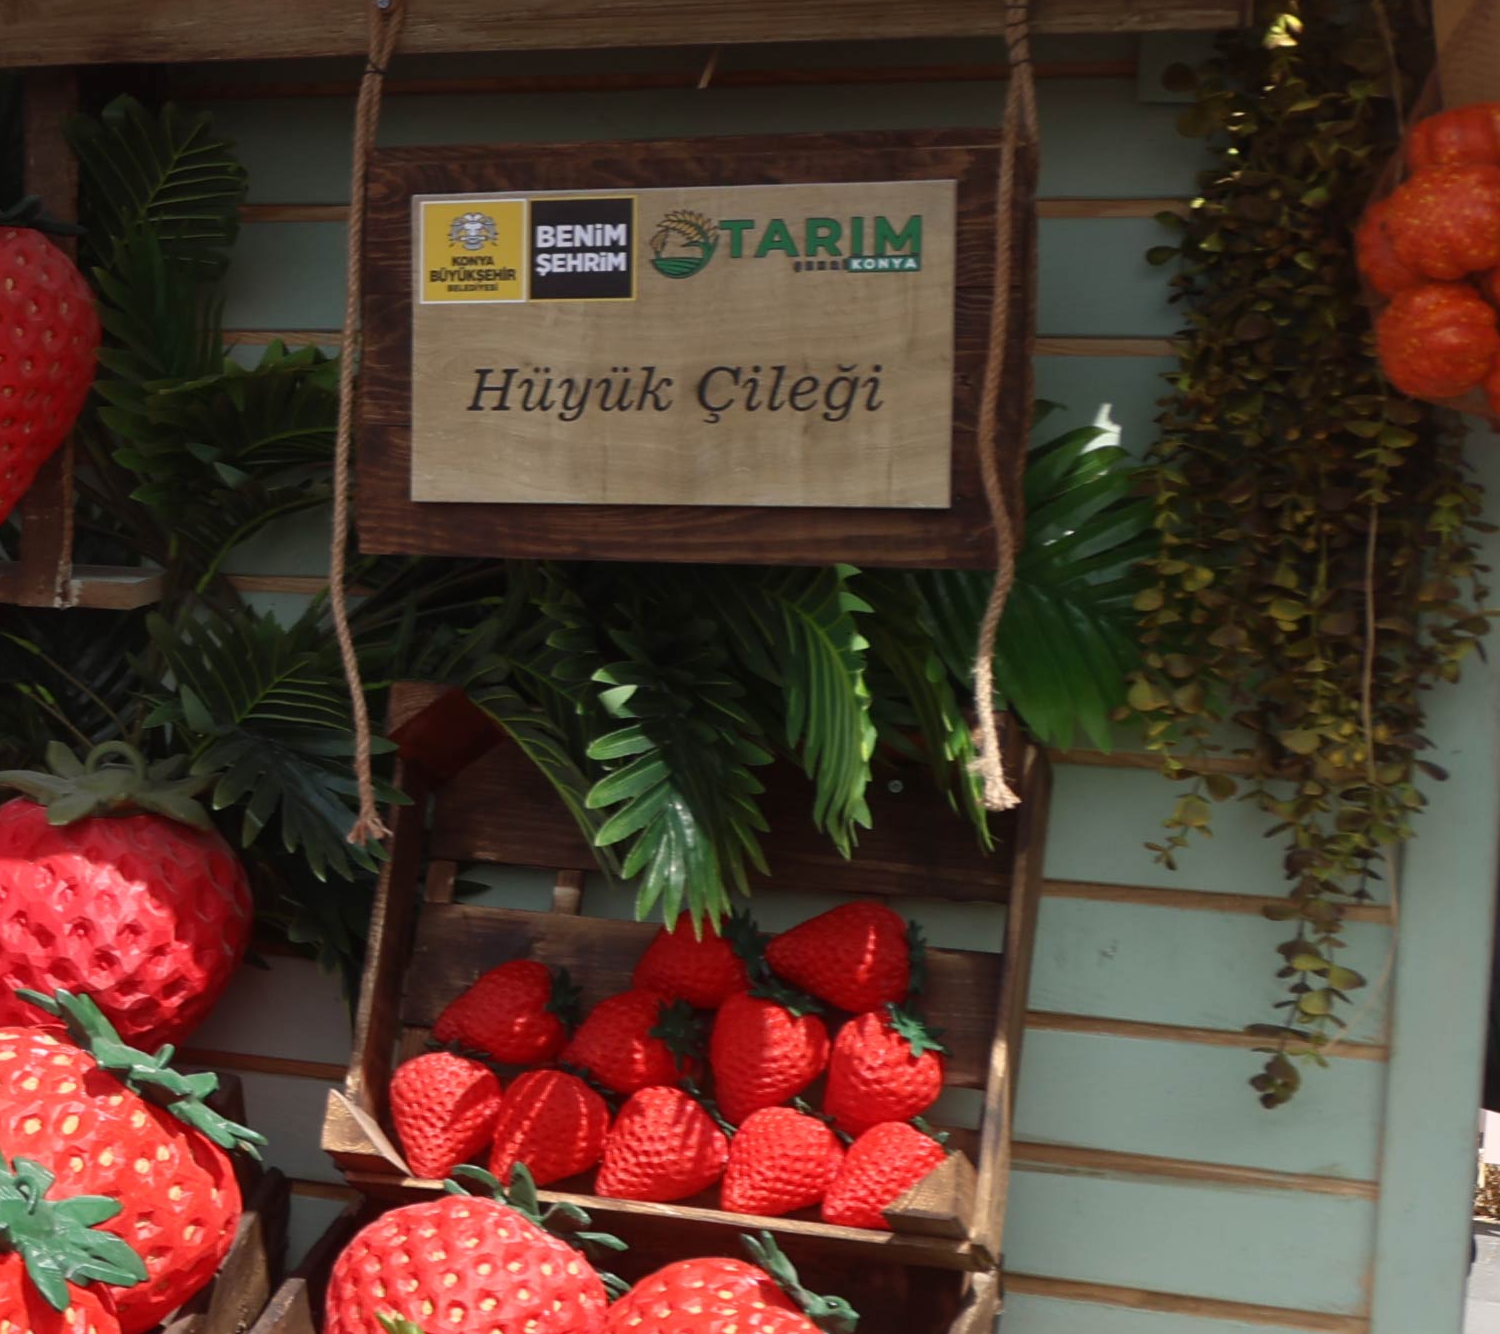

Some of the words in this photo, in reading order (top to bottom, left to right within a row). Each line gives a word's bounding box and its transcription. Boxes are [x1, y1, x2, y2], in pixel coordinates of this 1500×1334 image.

[719, 214, 924, 259] TARIM
[451, 256, 495, 267] KONYA
[850, 258, 918, 270] KONYA
[466, 366, 674, 422] Hüyük
[697, 364, 886, 424] Çileği
